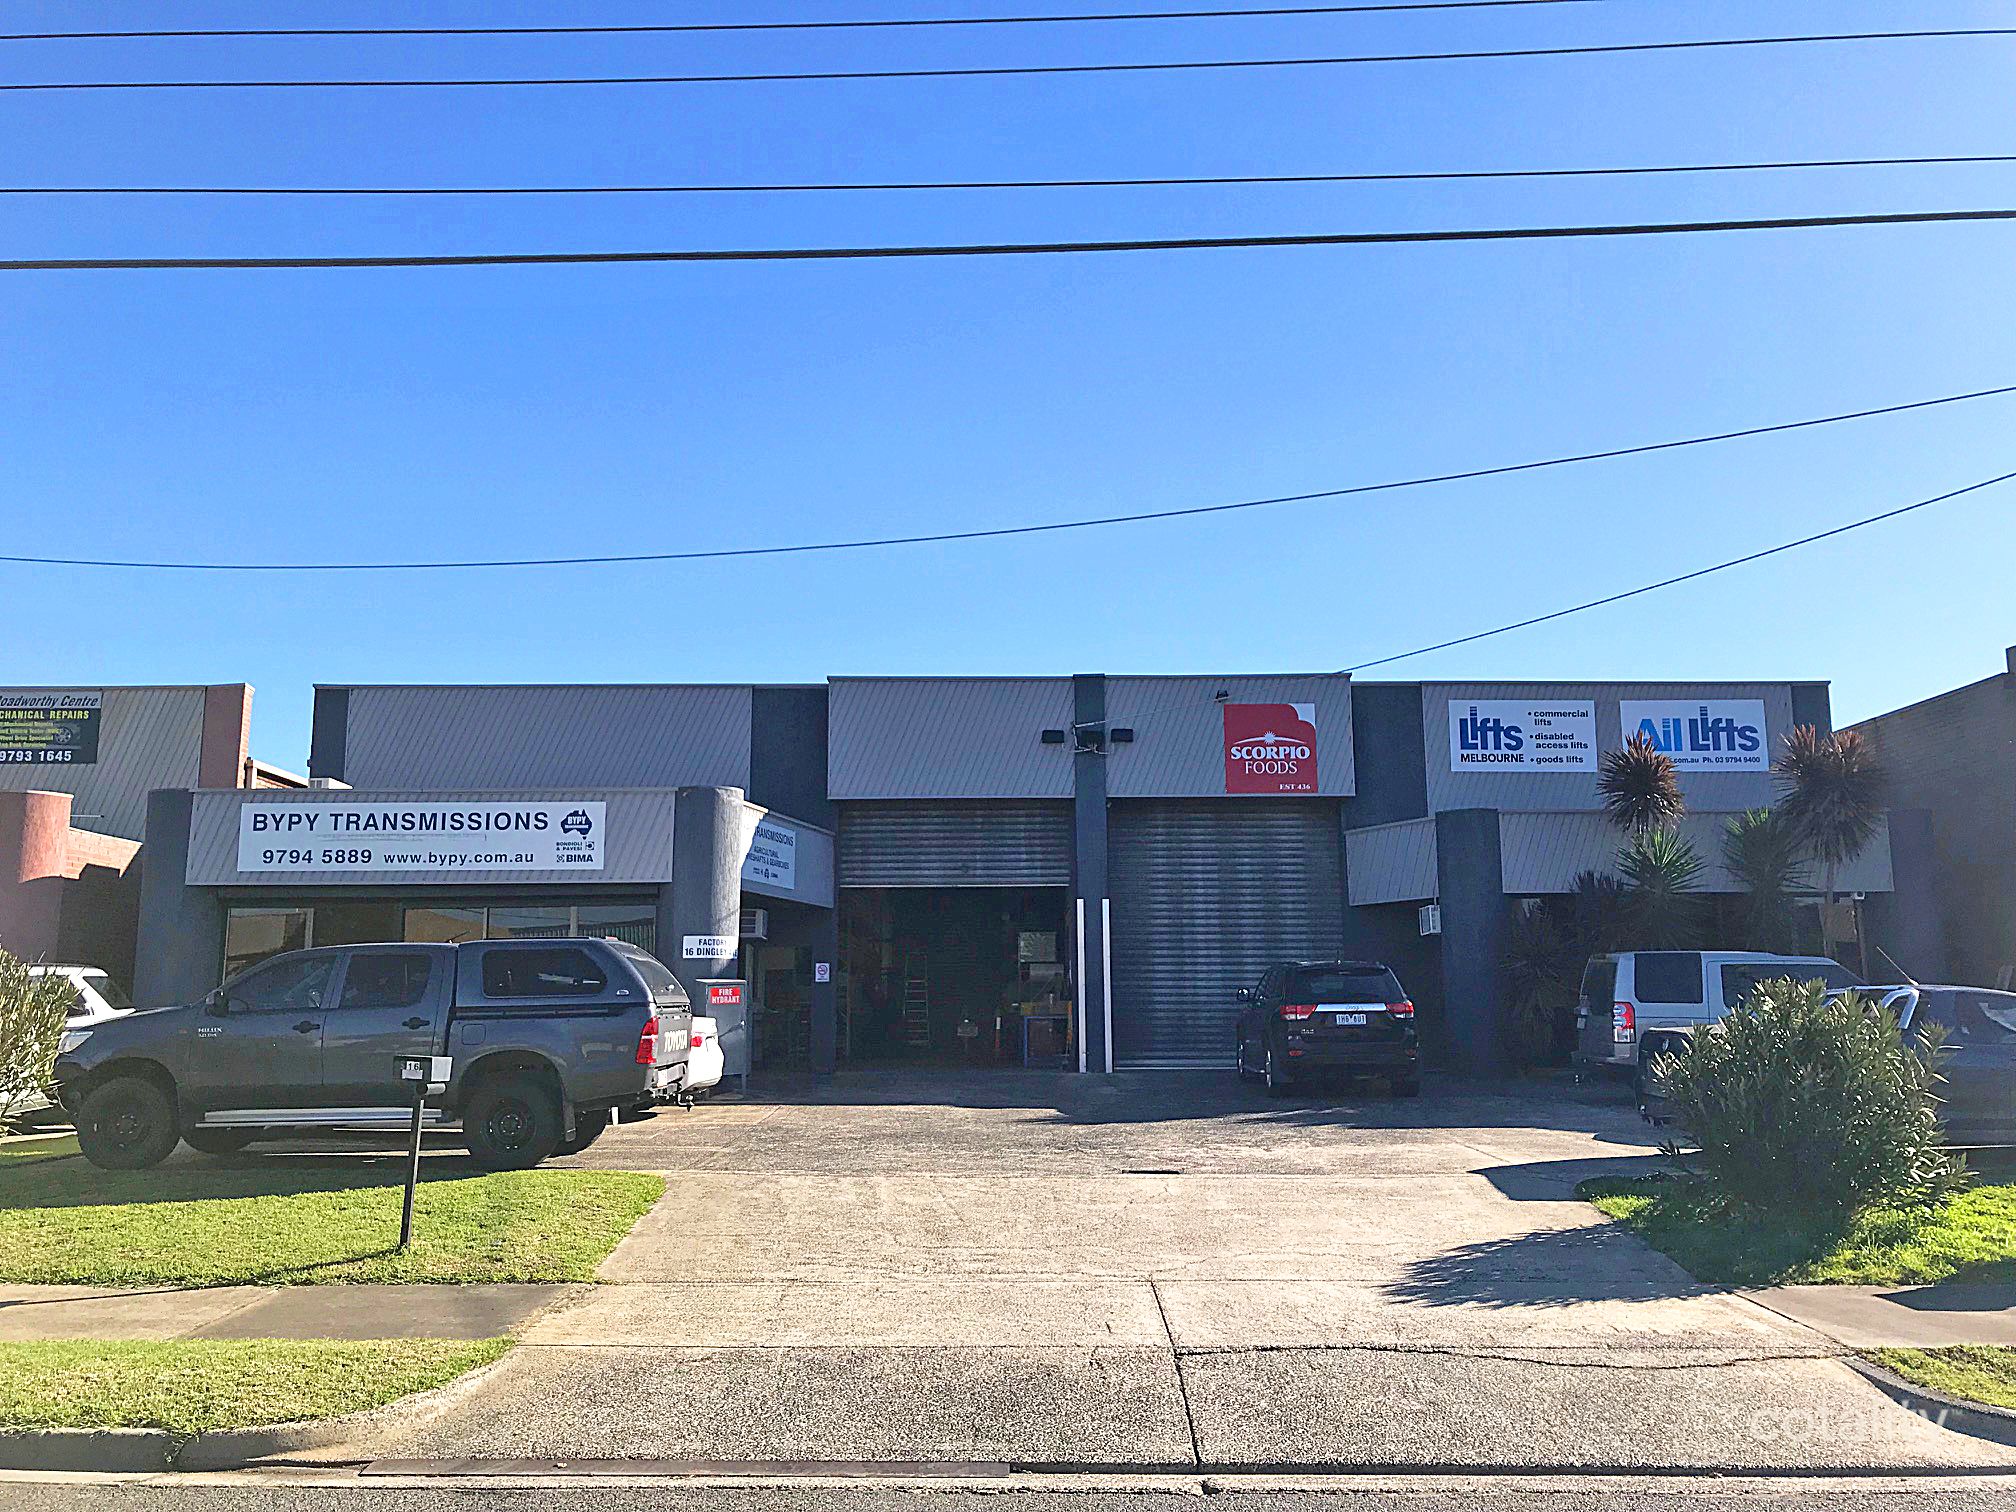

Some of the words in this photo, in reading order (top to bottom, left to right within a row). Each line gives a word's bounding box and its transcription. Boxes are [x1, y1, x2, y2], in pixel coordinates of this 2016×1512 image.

[0, 695, 59, 708] oadworthy
[61, 695, 98, 706] Centre
[50, 710, 89, 719] REPAIRS
[1459, 706, 1524, 751] Lifts
[1688, 706, 1760, 751] Lifts
[1570, 741, 1588, 749] lifts
[0, 750, 32, 761] 9793
[38, 750, 72, 761] 1645
[1230, 746, 1311, 760] SCORPIO
[1460, 754, 1524, 762] MELBOURNE
[1536, 756, 1564, 764] goods
[1566, 755, 1584, 763] lifts
[1245, 760, 1298, 774] FOODS
[252, 813, 320, 831] BYPY
[329, 812, 548, 831] TRANSMISSIONS
[567, 816, 586, 824] BYPY
[262, 850, 313, 864] 9794
[321, 849, 372, 864] 5889
[384, 851, 534, 866] www.bypy.com.au
[566, 854, 593, 862] BIMA
[718, 988, 733, 996] FIRE
[711, 995, 740, 1004] HYDRANT
[664, 1029, 688, 1052] TOYOTA
[409, 1063, 420, 1071] 16
